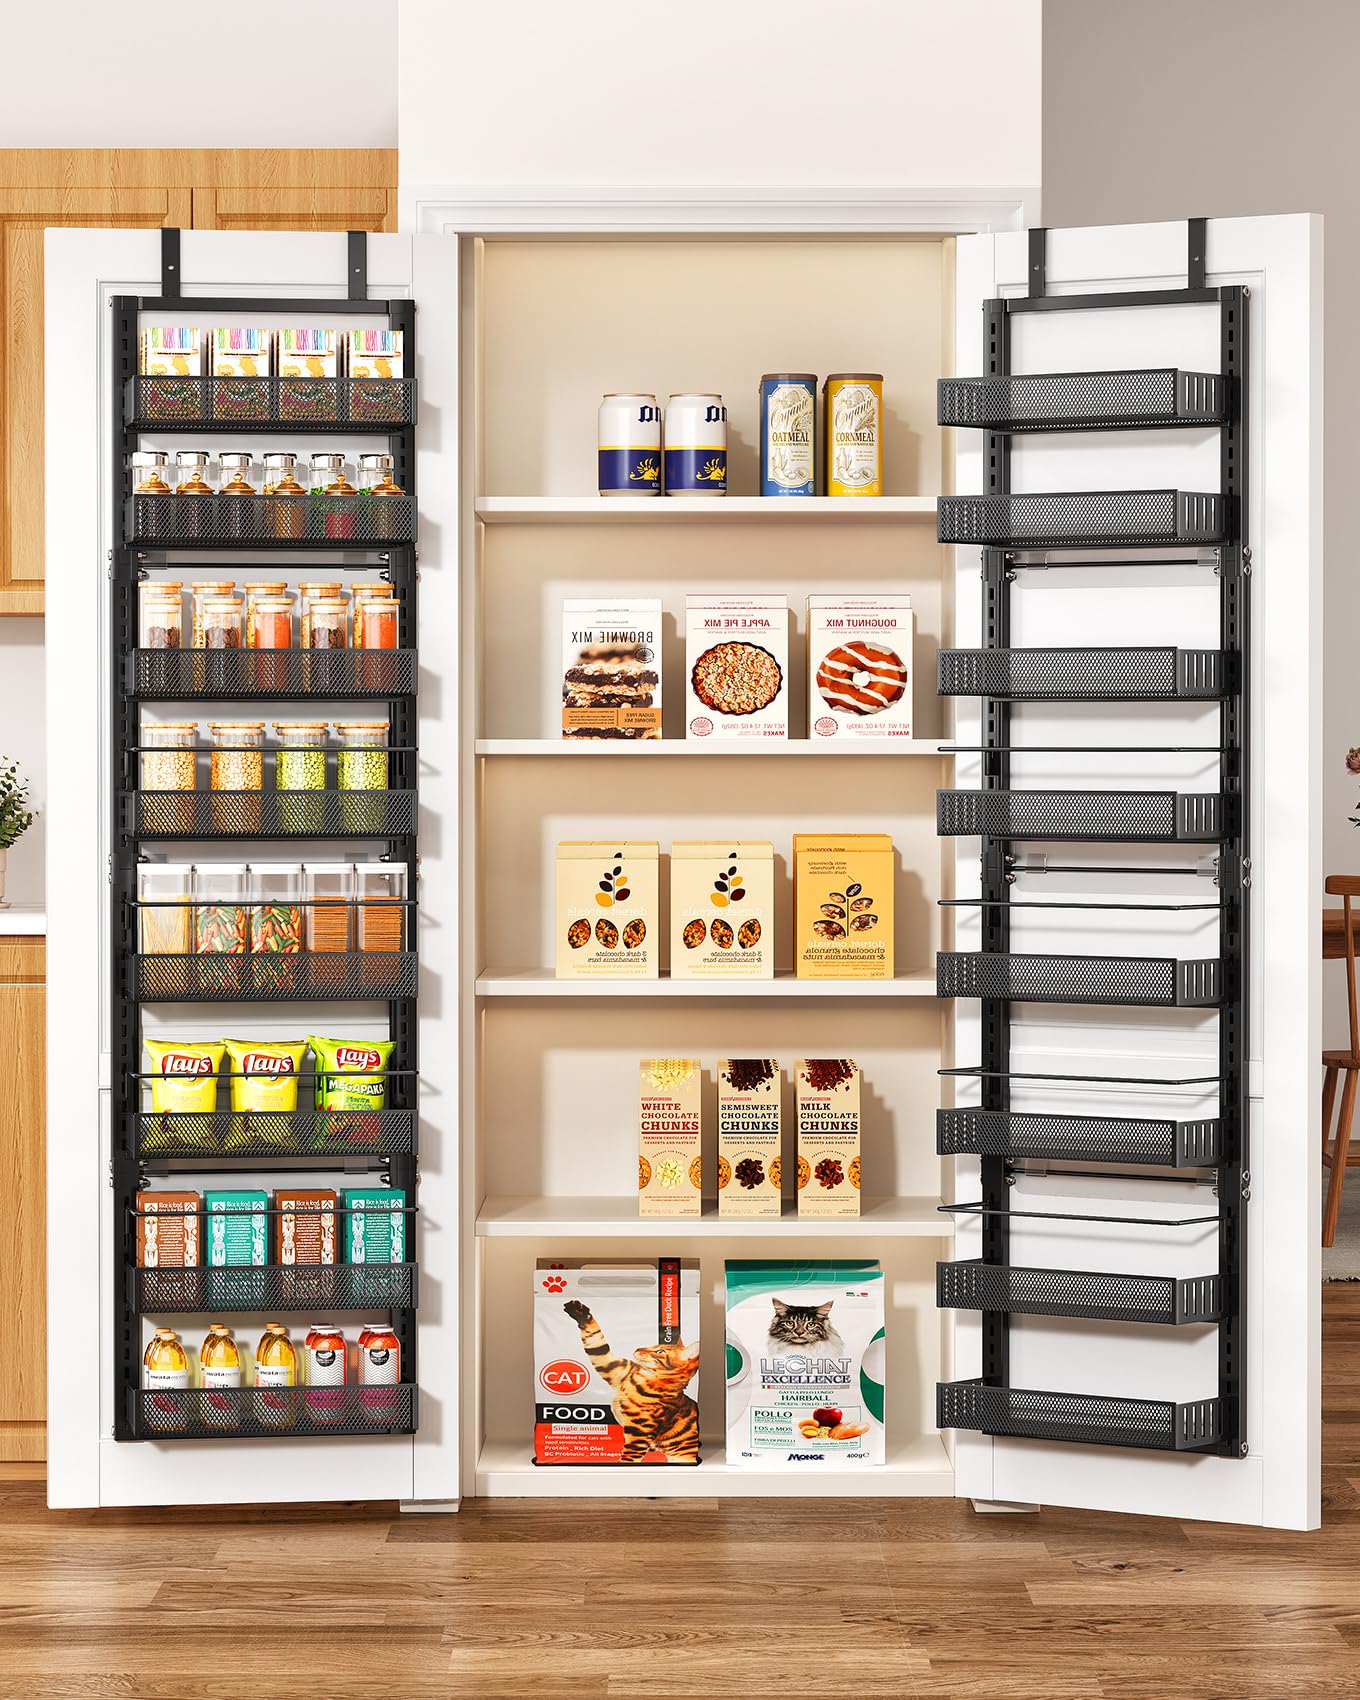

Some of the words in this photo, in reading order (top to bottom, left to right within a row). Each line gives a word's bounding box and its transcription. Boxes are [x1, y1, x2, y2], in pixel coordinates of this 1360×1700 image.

[772, 432, 810, 442] OATMEAL
[836, 432, 875, 442] CORNMEAL
[328, 1079, 384, 1095] MEGAPAKA
[641, 1103, 681, 1111] WHITE
[800, 1103, 831, 1111] MILK
[641, 1121, 699, 1131] CHUNKS
[721, 1121, 779, 1131] CHUNKS
[800, 1121, 858, 1131] CHUNKS
[664, 1277, 674, 1297] Recipe
[664, 1297, 672, 1312] Duck
[664, 1312, 672, 1326] Free
[664, 1326, 672, 1343] Grain
[760, 1358, 852, 1374] LECHAT
[544, 1371, 585, 1385] CAT
[761, 1375, 852, 1384] EXCELLENCE
[543, 1407, 606, 1421] FOOD
[754, 1410, 793, 1418] POLLO
[787, 1453, 825, 1461] MONGE
